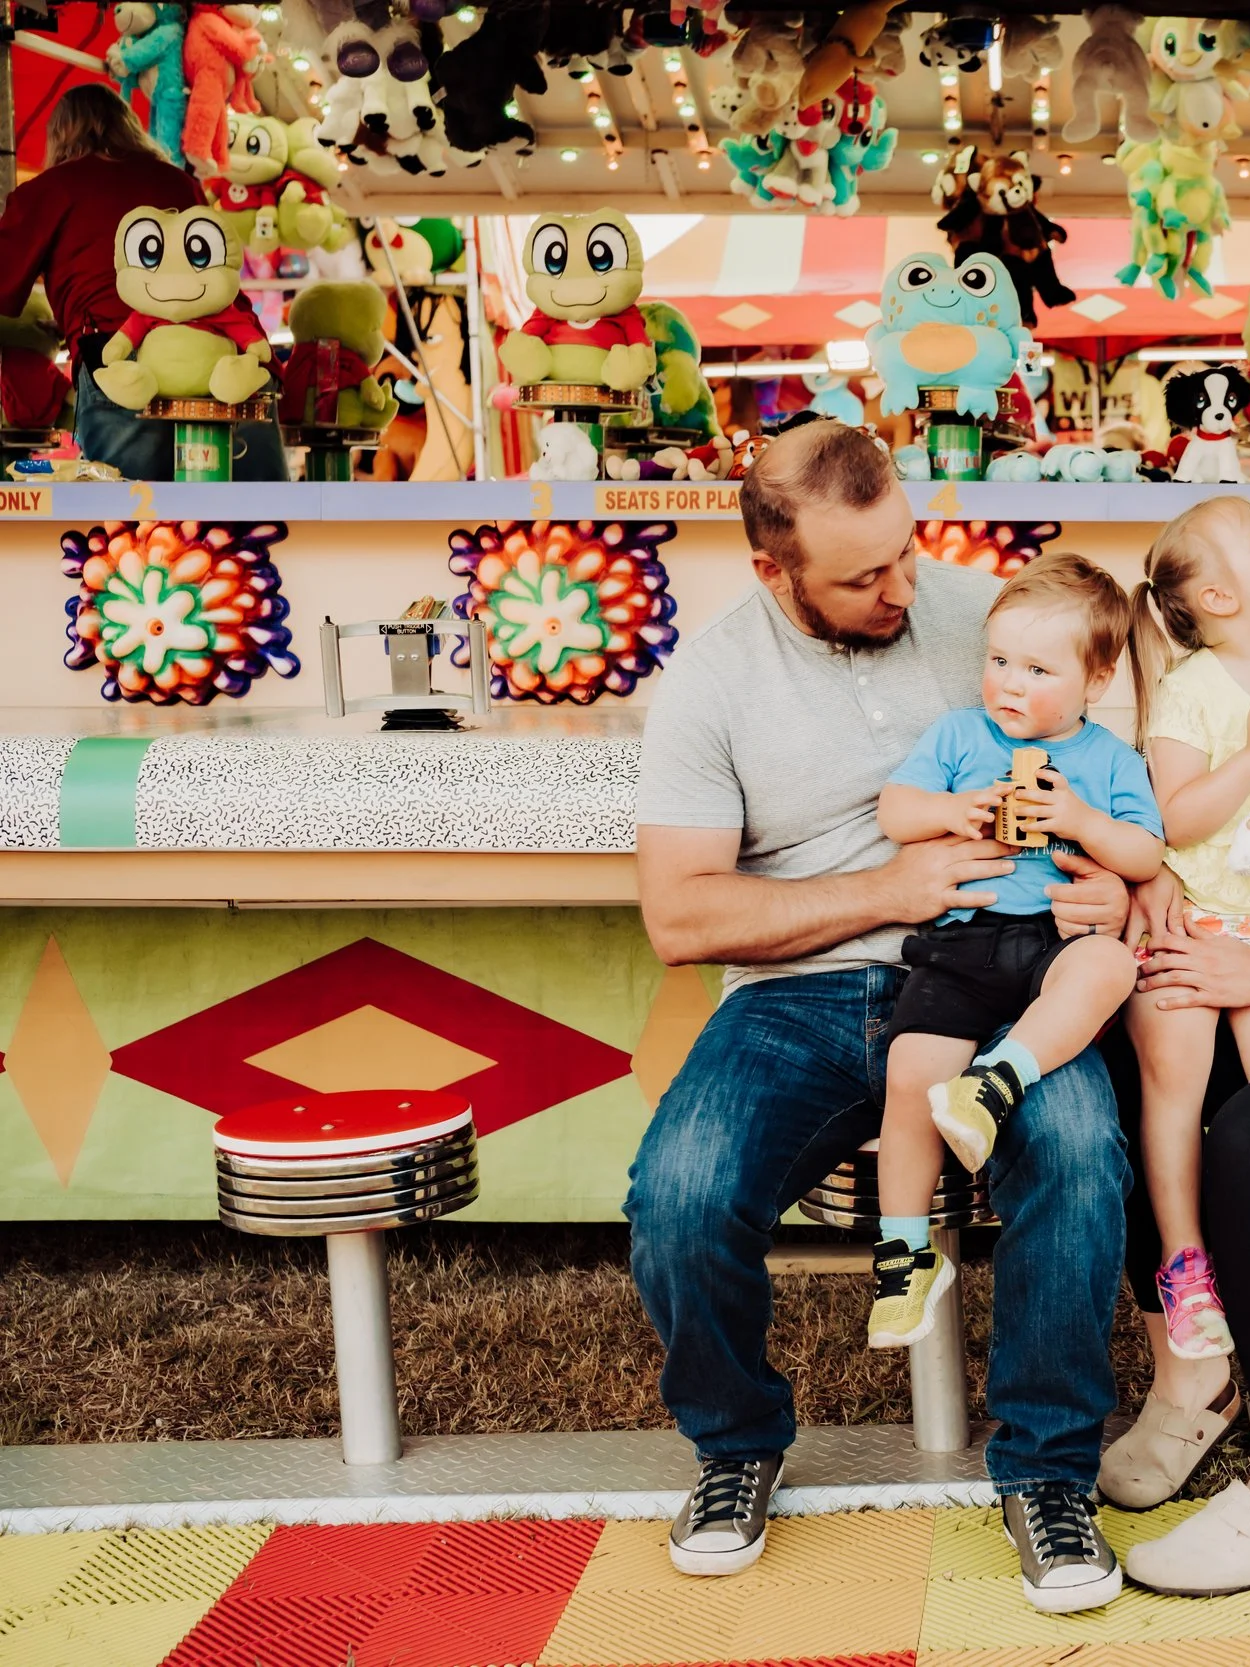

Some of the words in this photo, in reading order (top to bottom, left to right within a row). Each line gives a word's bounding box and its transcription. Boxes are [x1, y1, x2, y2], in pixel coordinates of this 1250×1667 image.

[130, 483, 157, 519] 2
[530, 481, 553, 518] 3
[605, 490, 660, 510] SEATS
[666, 490, 700, 510] FOR
[706, 490, 740, 510] PLA
[927, 483, 963, 519] 4
